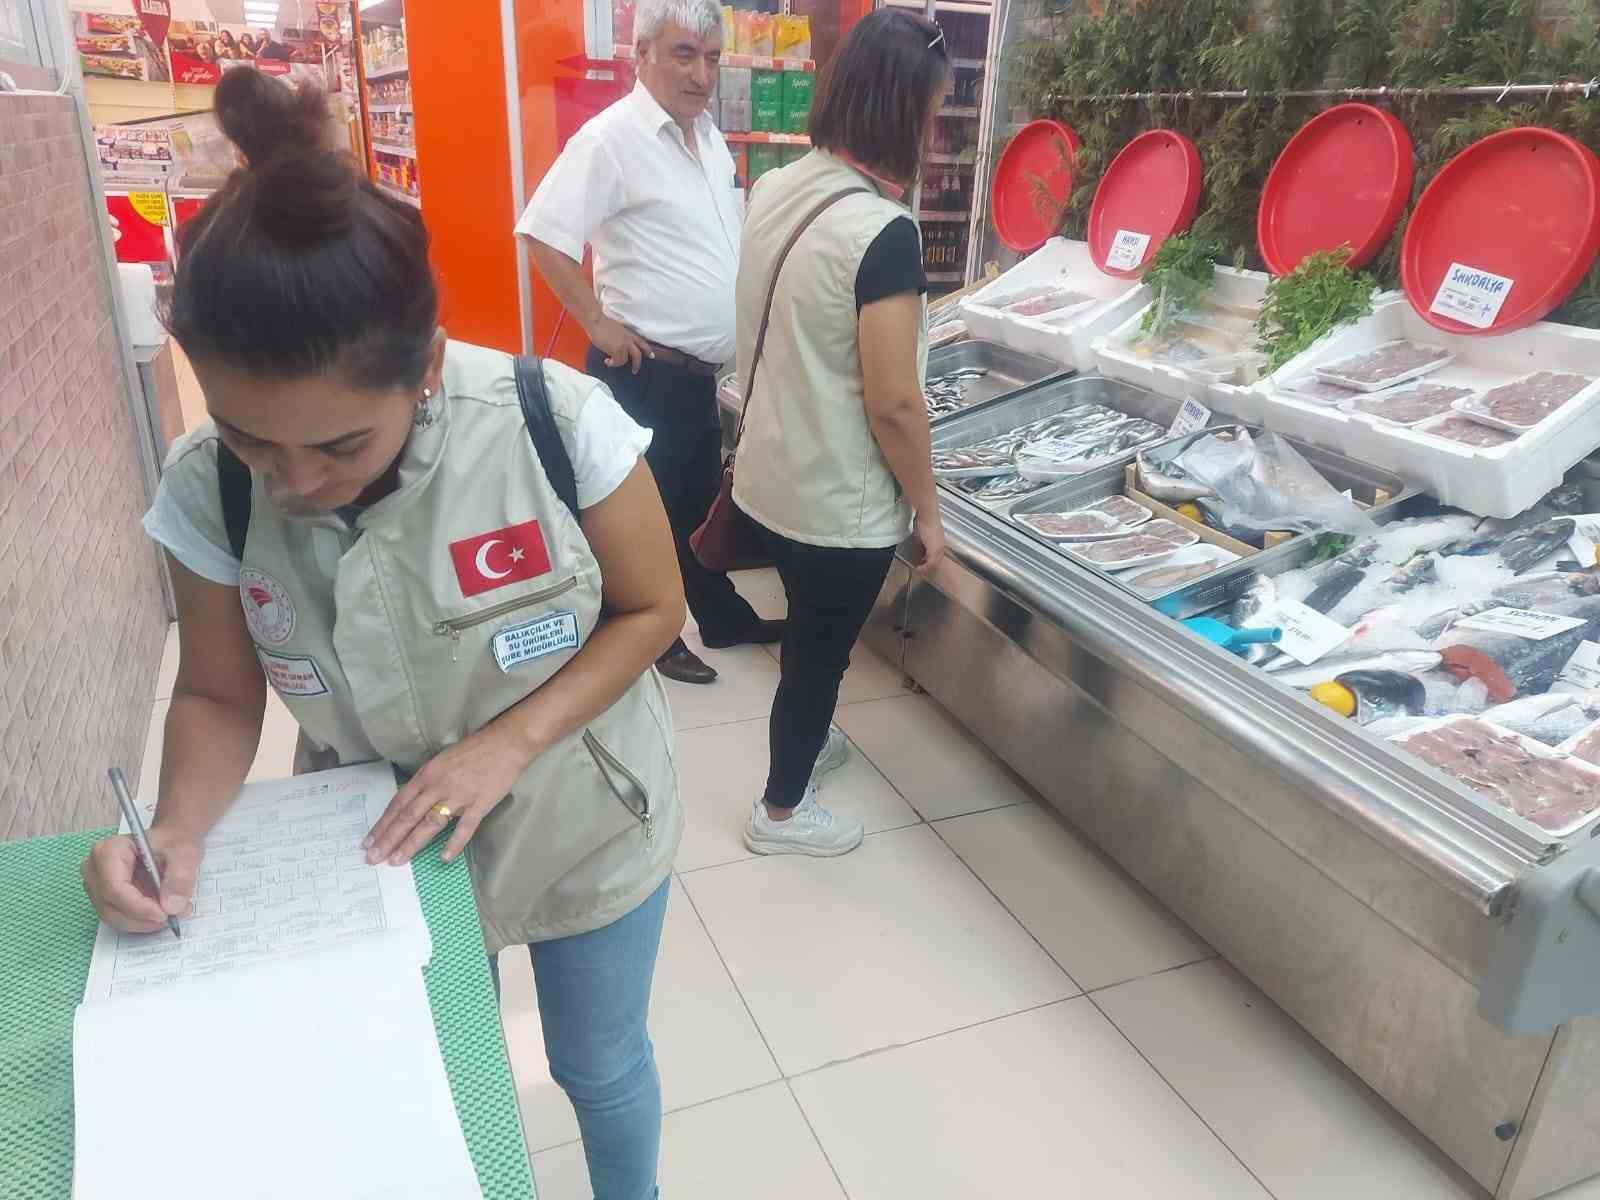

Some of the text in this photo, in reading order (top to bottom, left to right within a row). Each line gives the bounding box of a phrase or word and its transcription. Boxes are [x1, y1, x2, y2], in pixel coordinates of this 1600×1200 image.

[1452, 268, 1505, 293] SARDALYA
[504, 618, 566, 642] BALIKÇILIK VE
[508, 641, 521, 651] SU
